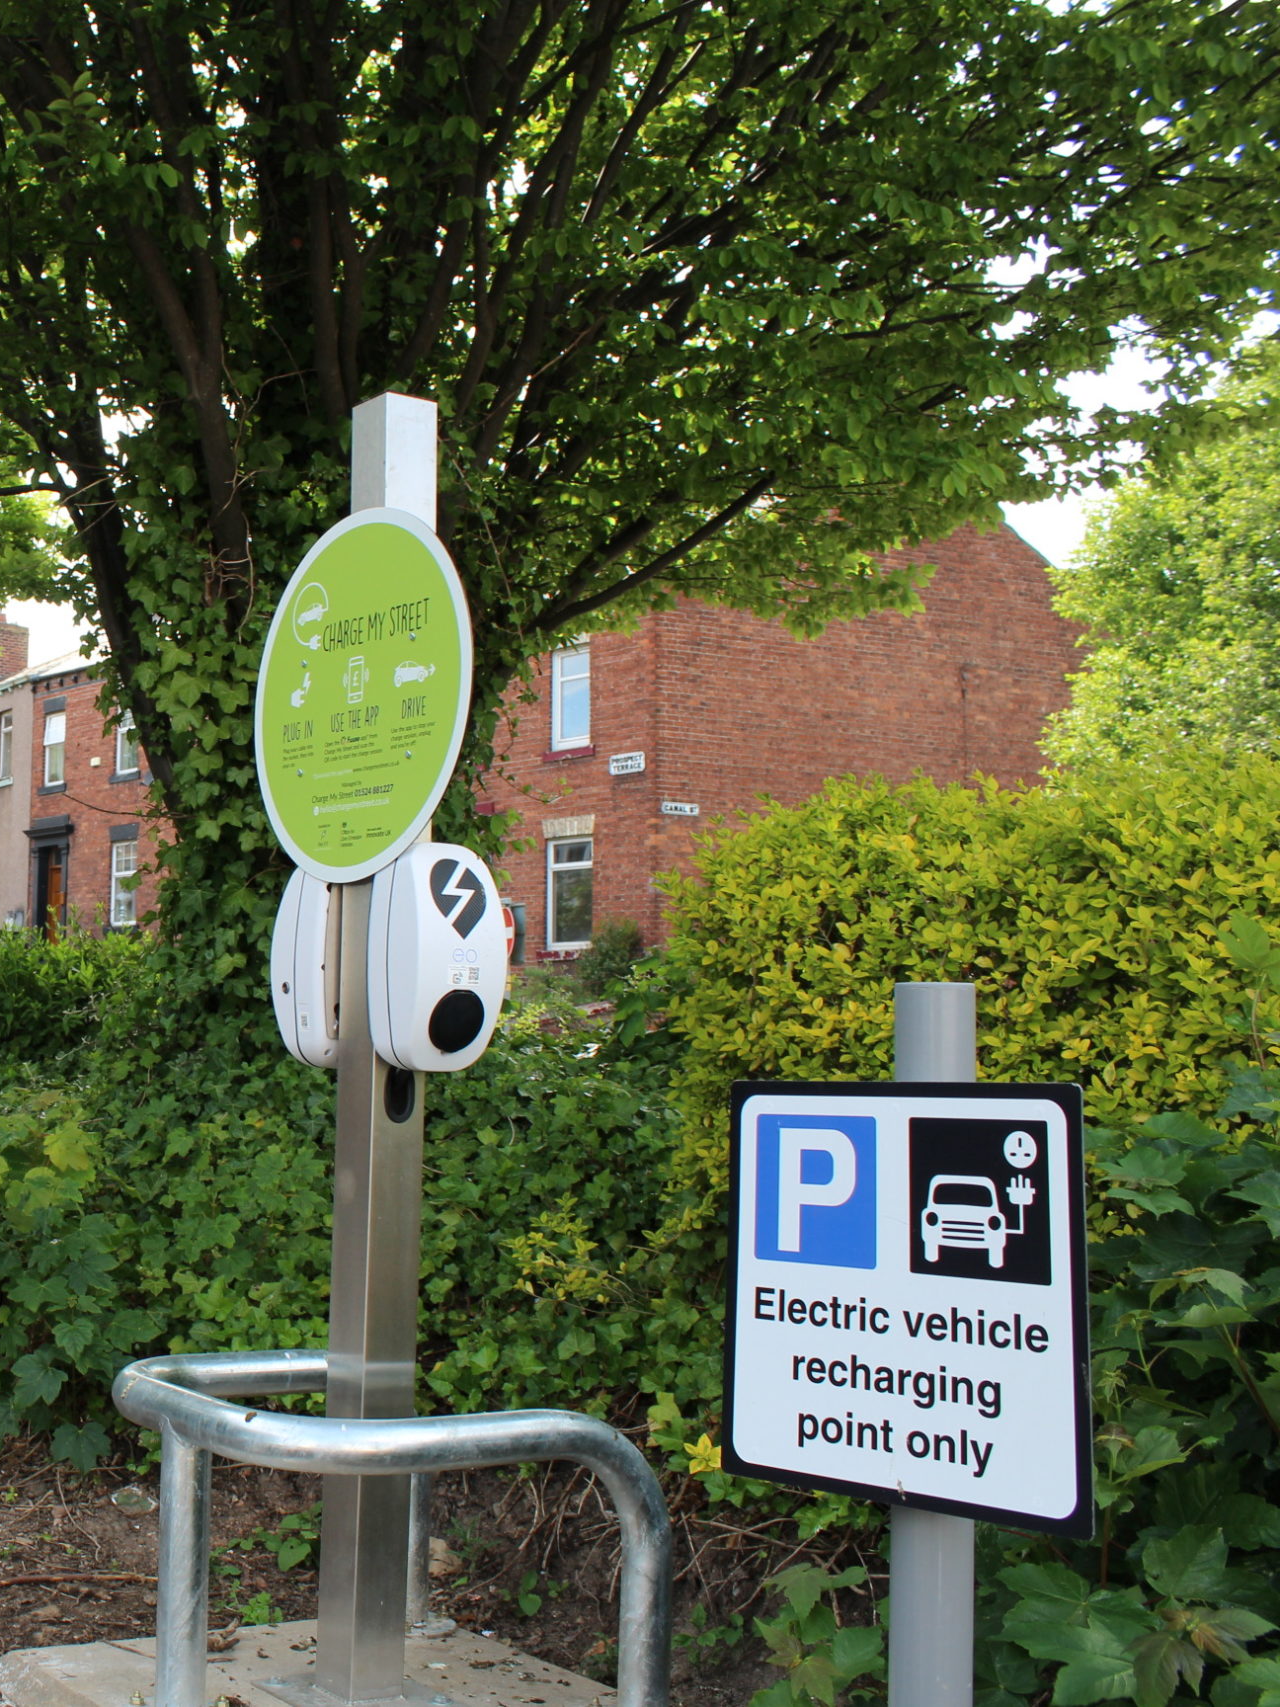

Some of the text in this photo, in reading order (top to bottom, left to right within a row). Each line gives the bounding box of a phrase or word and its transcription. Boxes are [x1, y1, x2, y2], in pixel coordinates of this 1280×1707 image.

[322, 598, 430, 652] CHARGE MY STREET
[331, 705, 380, 733] USE THE APP
[401, 696, 426, 719] DRIVE
[283, 720, 313, 743] PLUG IN
[613, 762, 641, 772] TERRACE
[664, 804, 687, 813] CANAL
[452, 948, 478, 963] eo
[777, 1127, 856, 1253] P
[754, 1286, 1049, 1353] Electric vehicle
[792, 1354, 1002, 1419] recharging
[797, 1411, 993, 1478] point only
